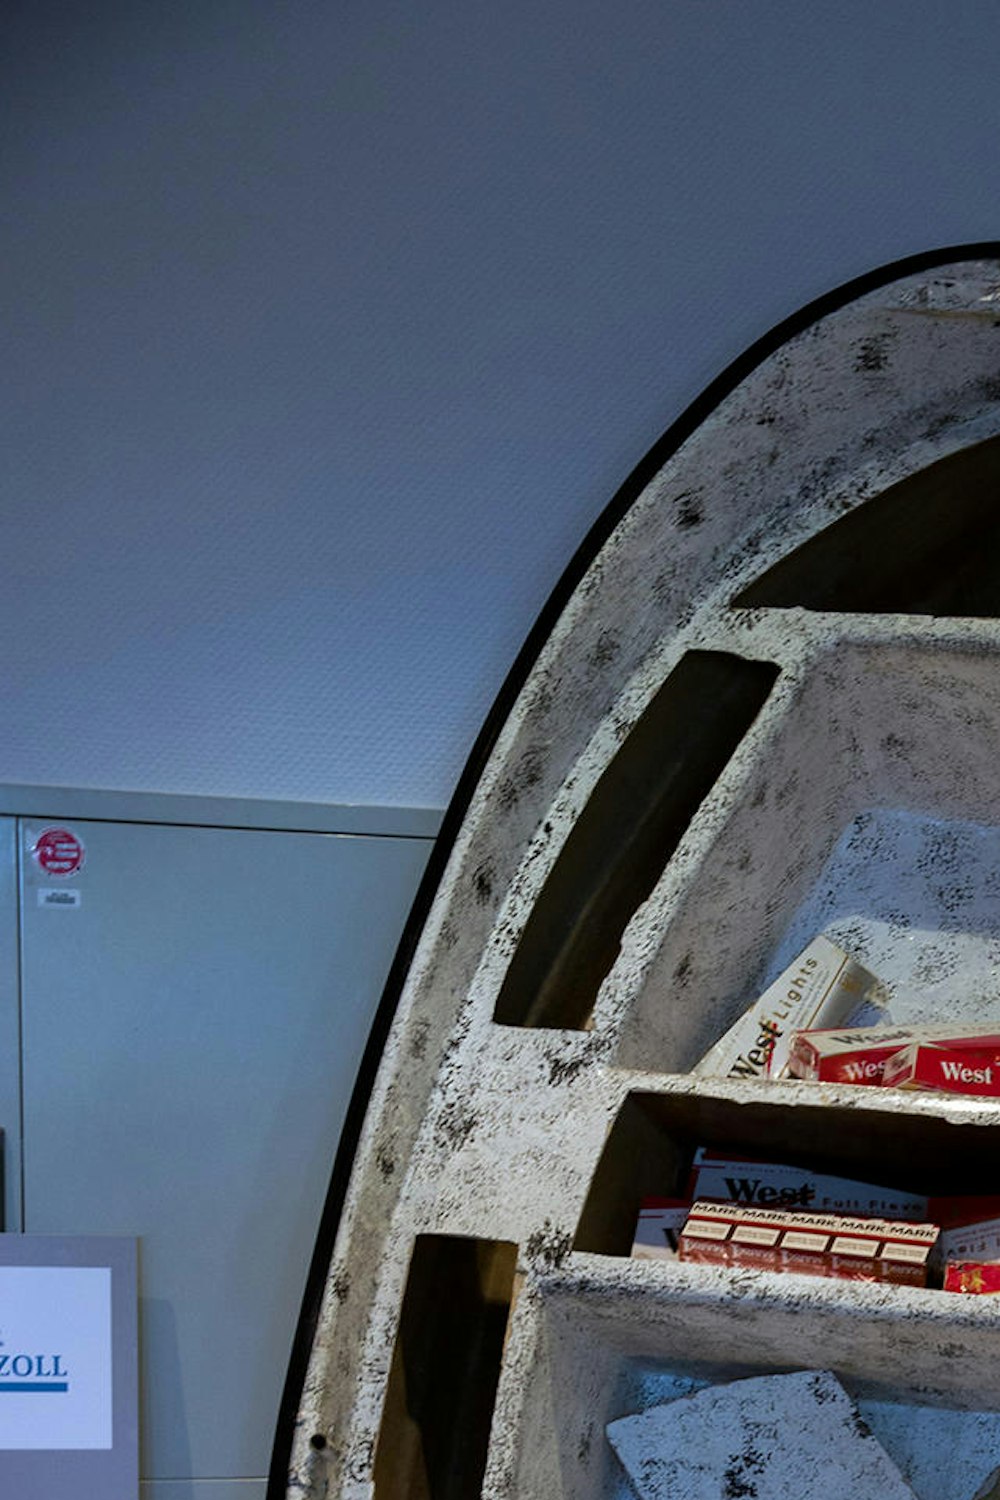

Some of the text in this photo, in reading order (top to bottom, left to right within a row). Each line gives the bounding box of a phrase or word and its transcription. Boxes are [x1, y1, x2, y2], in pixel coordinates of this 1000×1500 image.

[726, 957, 818, 1080] West Lights
[842, 1058, 888, 1083] Wes
[940, 1060, 993, 1085] West
[725, 1177, 816, 1207] West
[693, 1203, 738, 1218] MARK
[742, 1210, 788, 1225] MARK
[791, 1216, 836, 1232] MARK
[840, 1221, 886, 1237] MARK
[890, 1226, 937, 1242] MARK
[0, 1355, 68, 1377] ZOLL
